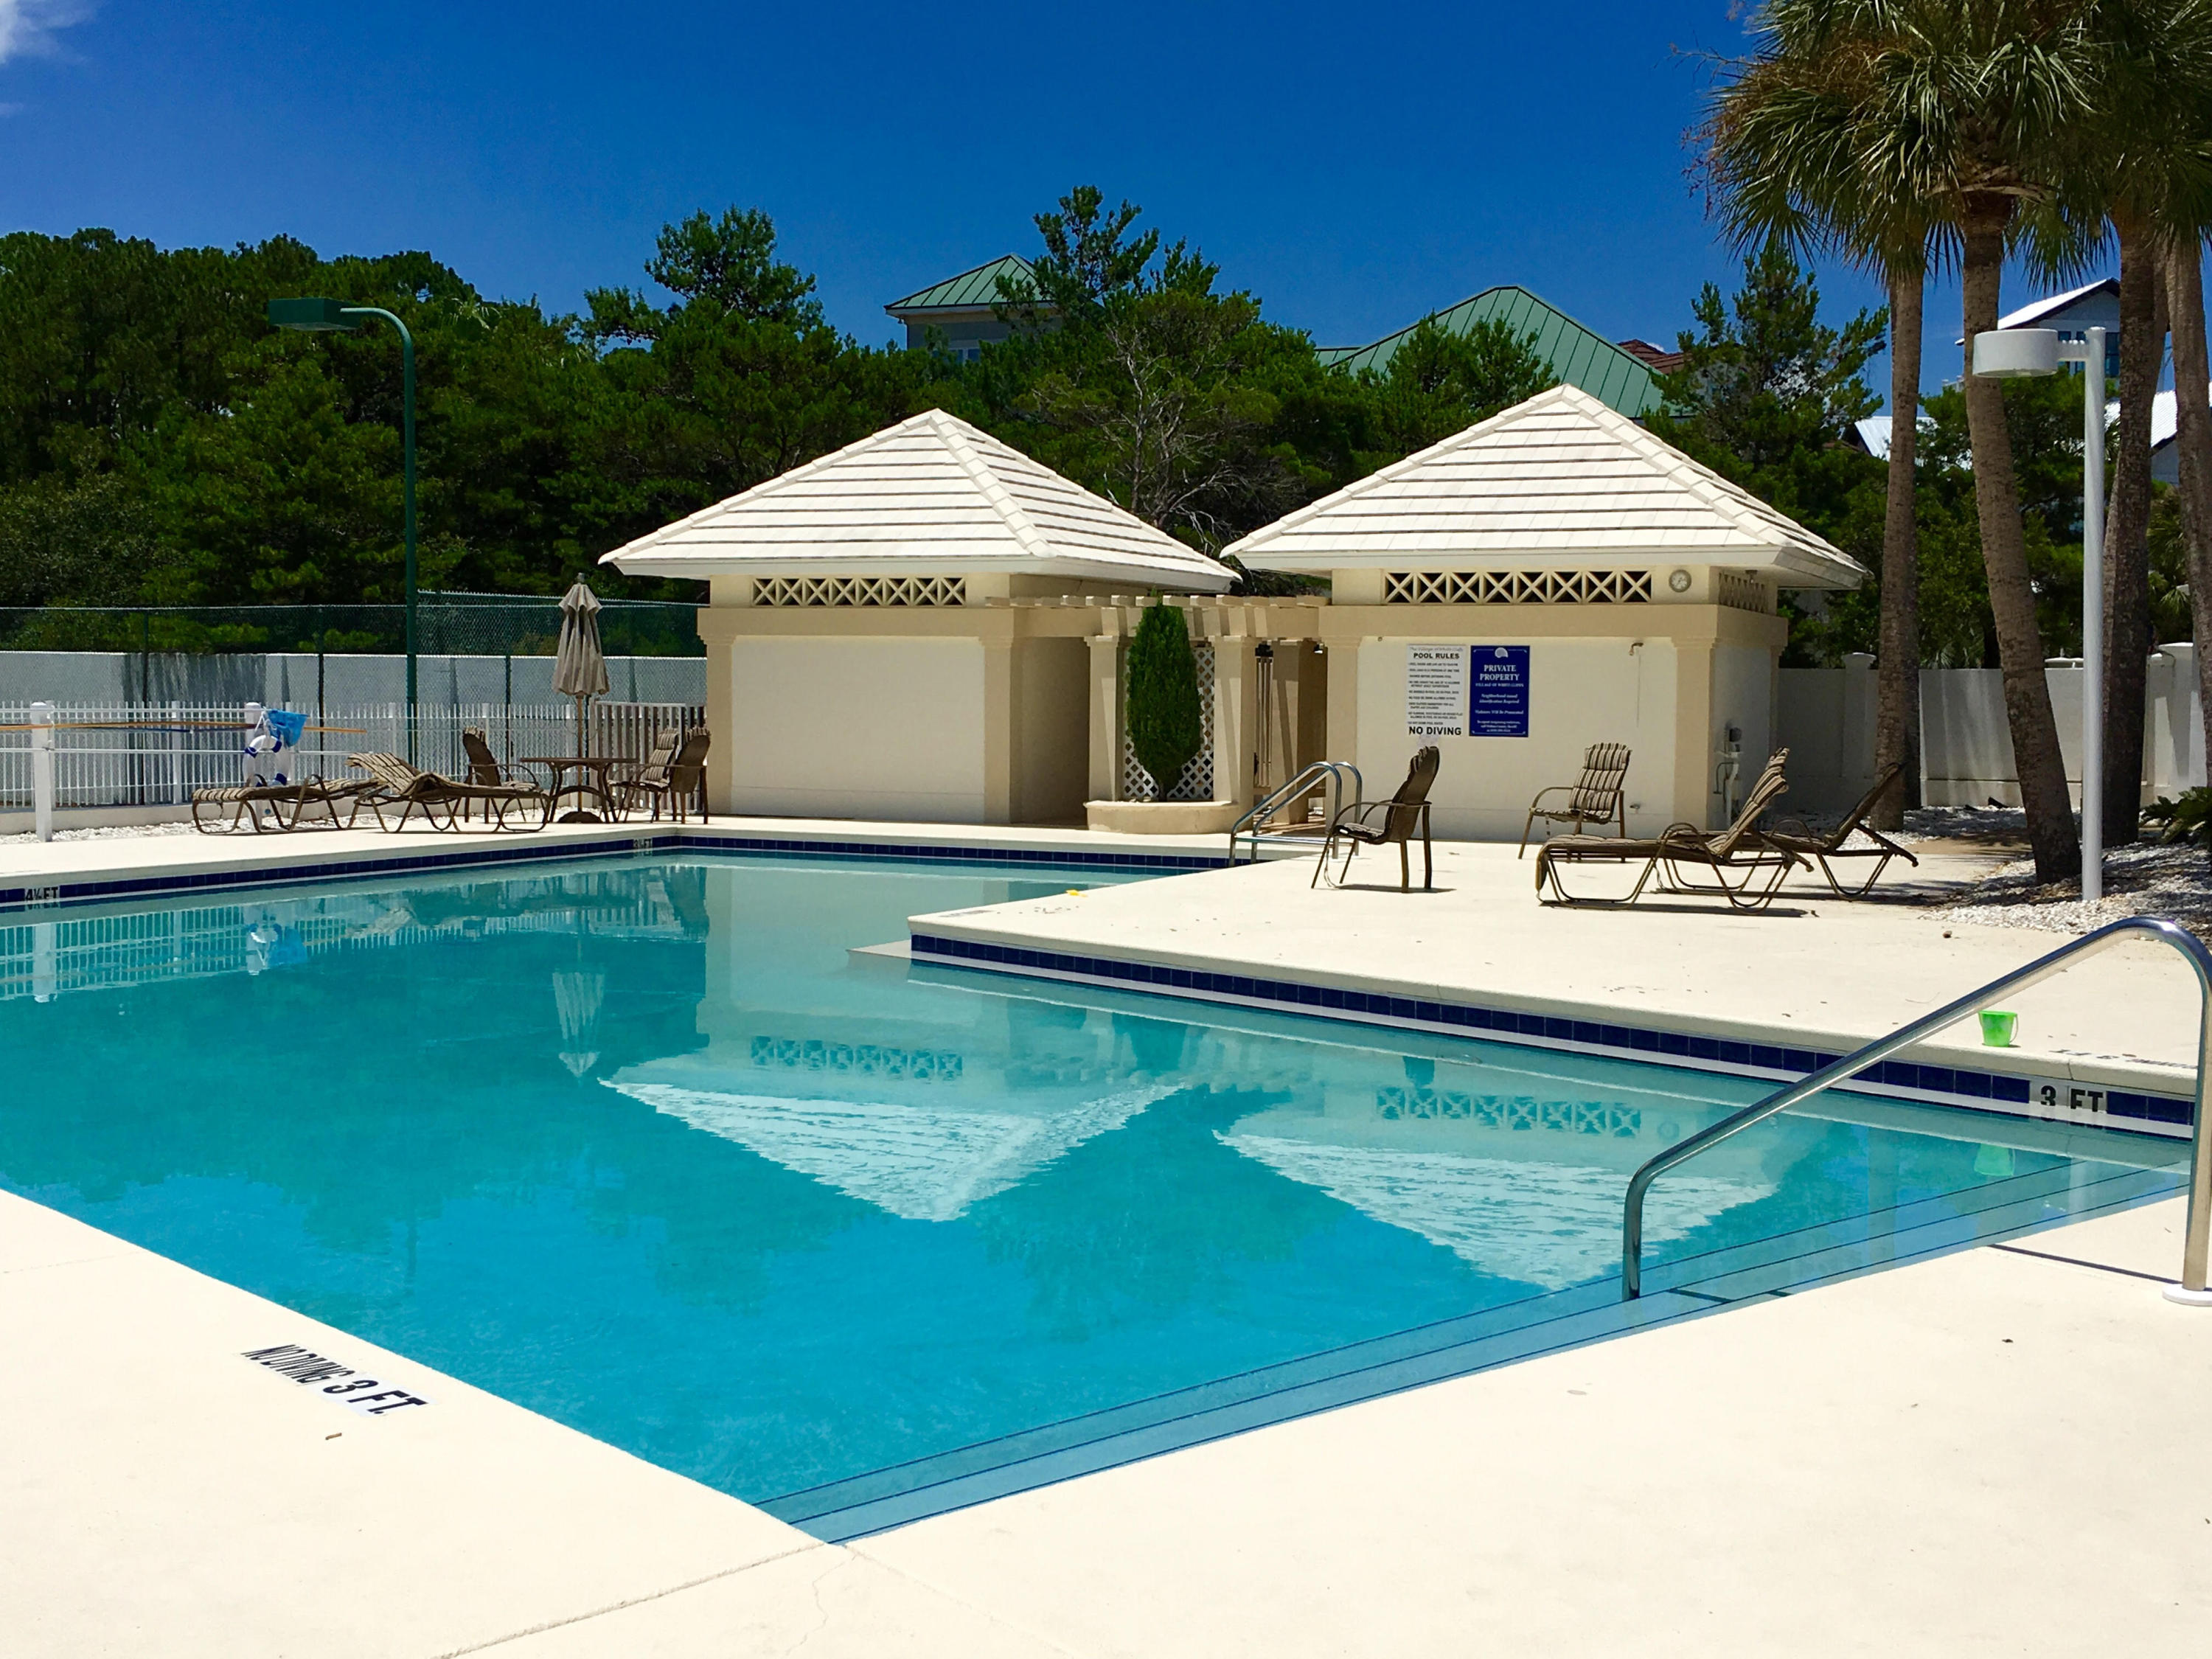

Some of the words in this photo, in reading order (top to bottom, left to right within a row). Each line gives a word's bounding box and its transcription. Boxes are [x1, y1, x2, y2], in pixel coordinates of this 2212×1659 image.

[1409, 726, 1423, 735] NO
[1427, 726, 1461, 735] DIVING
[44, 886, 59, 900] FT
[2040, 1085, 2056, 1107] 3
[2070, 1088, 2104, 1112] FT
[322, 1379, 379, 1394] 3
